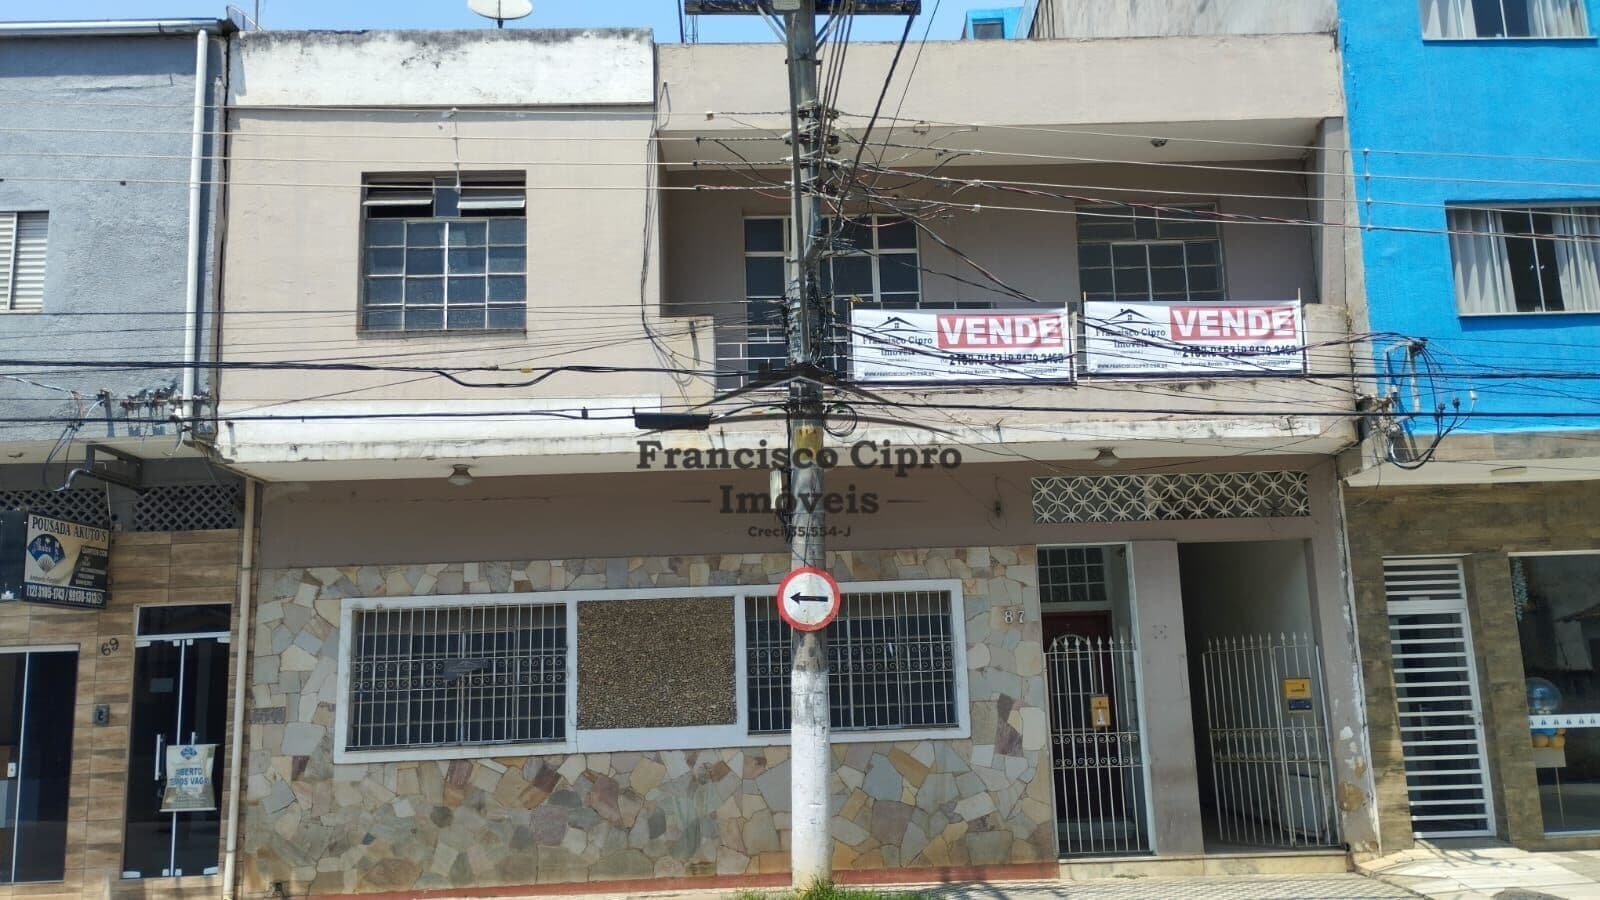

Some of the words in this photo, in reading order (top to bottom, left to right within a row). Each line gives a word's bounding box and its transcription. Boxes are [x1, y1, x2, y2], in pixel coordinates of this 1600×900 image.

[938, 316, 1063, 345] VENDE
[1171, 308, 1295, 337] VENDE
[32, 516, 71, 537] POUSADA
[73, 525, 107, 542] AKUTO'S
[1004, 610, 1025, 624] 87
[101, 637, 119, 656] 69
